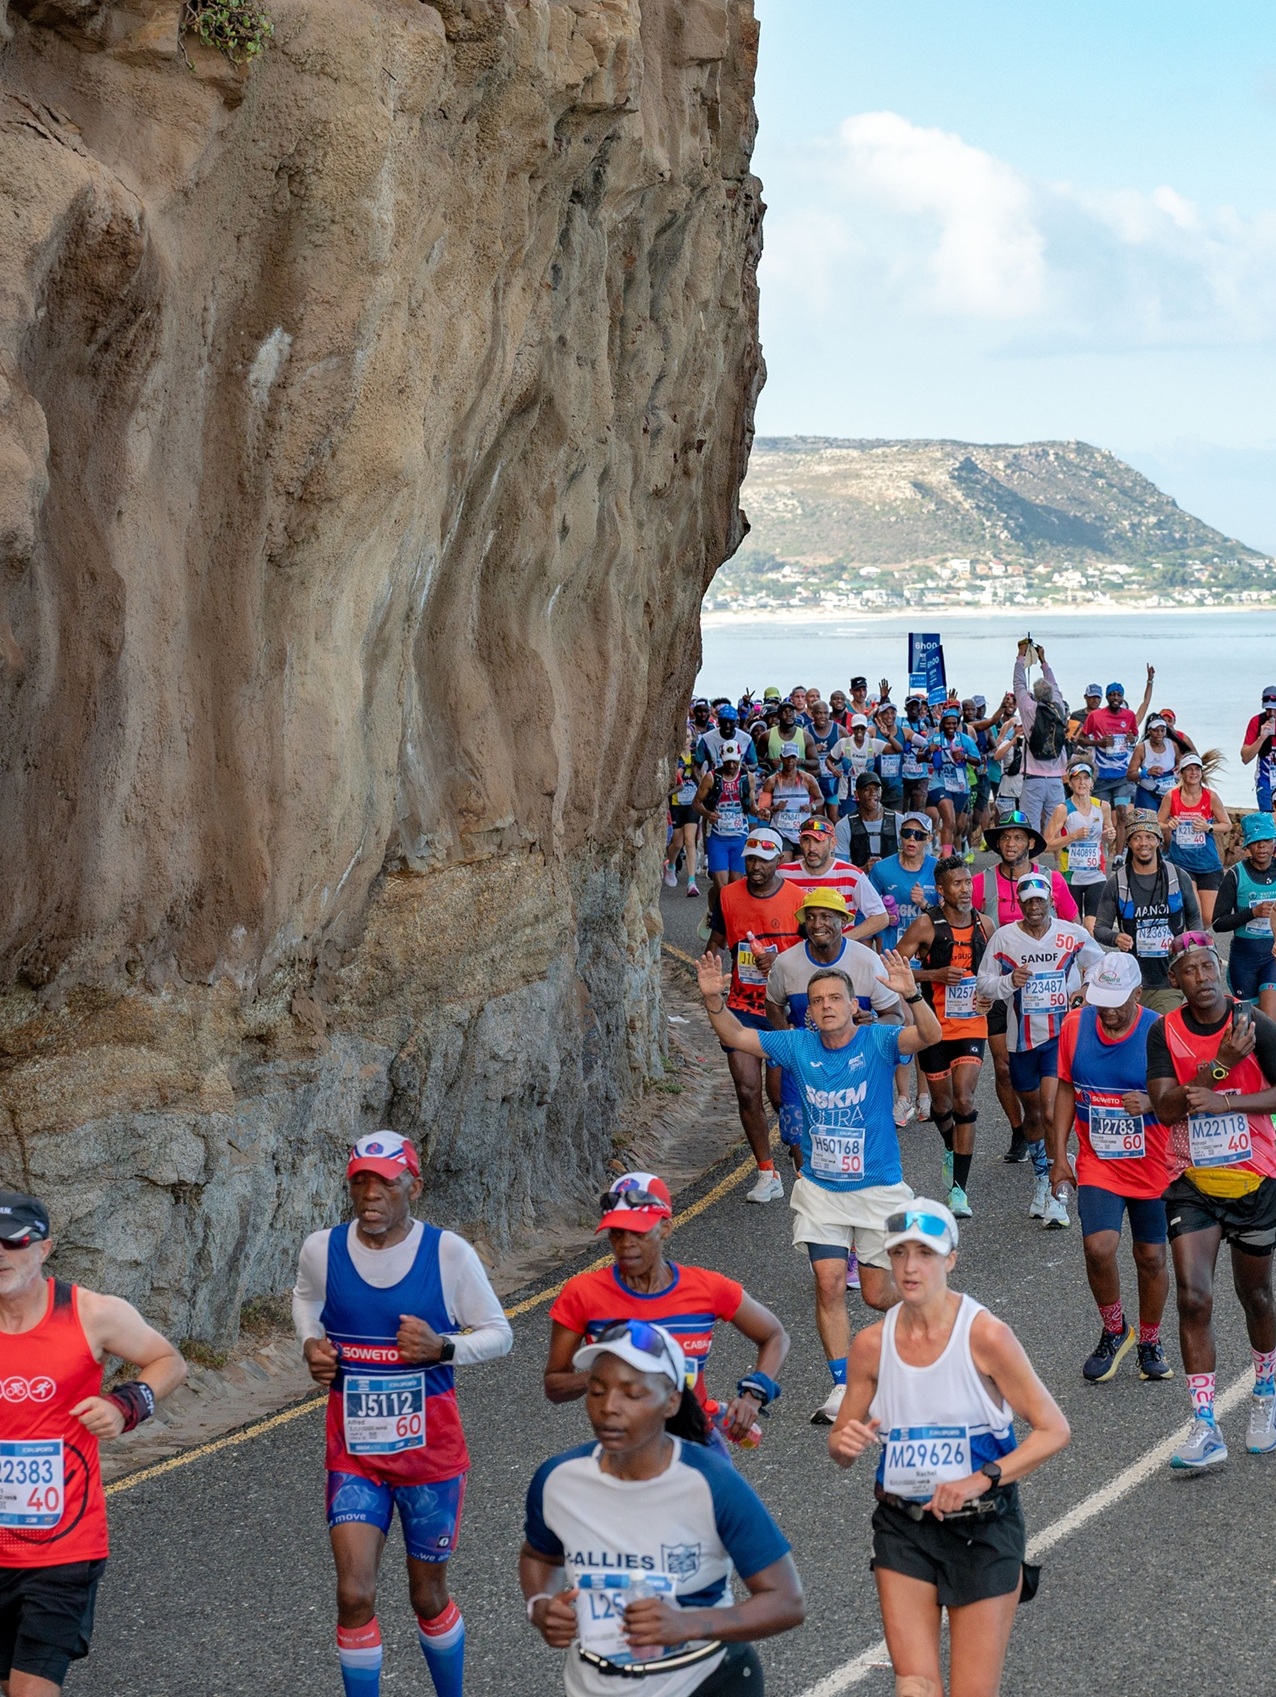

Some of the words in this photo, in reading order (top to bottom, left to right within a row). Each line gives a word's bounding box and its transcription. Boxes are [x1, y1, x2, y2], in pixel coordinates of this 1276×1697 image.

[1194, 835, 1204, 843] 40
[1071, 848, 1096, 857] N40895
[1087, 858, 1097, 866] 50
[1055, 933, 1074, 950] 50
[1021, 952, 1058, 964] SANDF
[949, 986, 974, 999] N257
[1025, 980, 1063, 994] P23487
[1050, 993, 1065, 1006] 50
[1098, 1119, 1135, 1135] J2783
[1192, 1115, 1245, 1139] M22118
[814, 1136, 860, 1154] H50168
[1123, 1134, 1142, 1150] 60
[1227, 1133, 1249, 1152] 40
[841, 1155, 861, 1172] 50
[342, 1347, 399, 1361] SOWETO
[358, 1391, 413, 1417] J5112
[396, 1414, 422, 1437] 60
[888, 1443, 964, 1468] M29626
[0, 1459, 53, 1485] 2383
[915, 1470, 937, 1478] Rachel
[26, 1486, 60, 1512] 40
[335, 1512, 366, 1523] move
